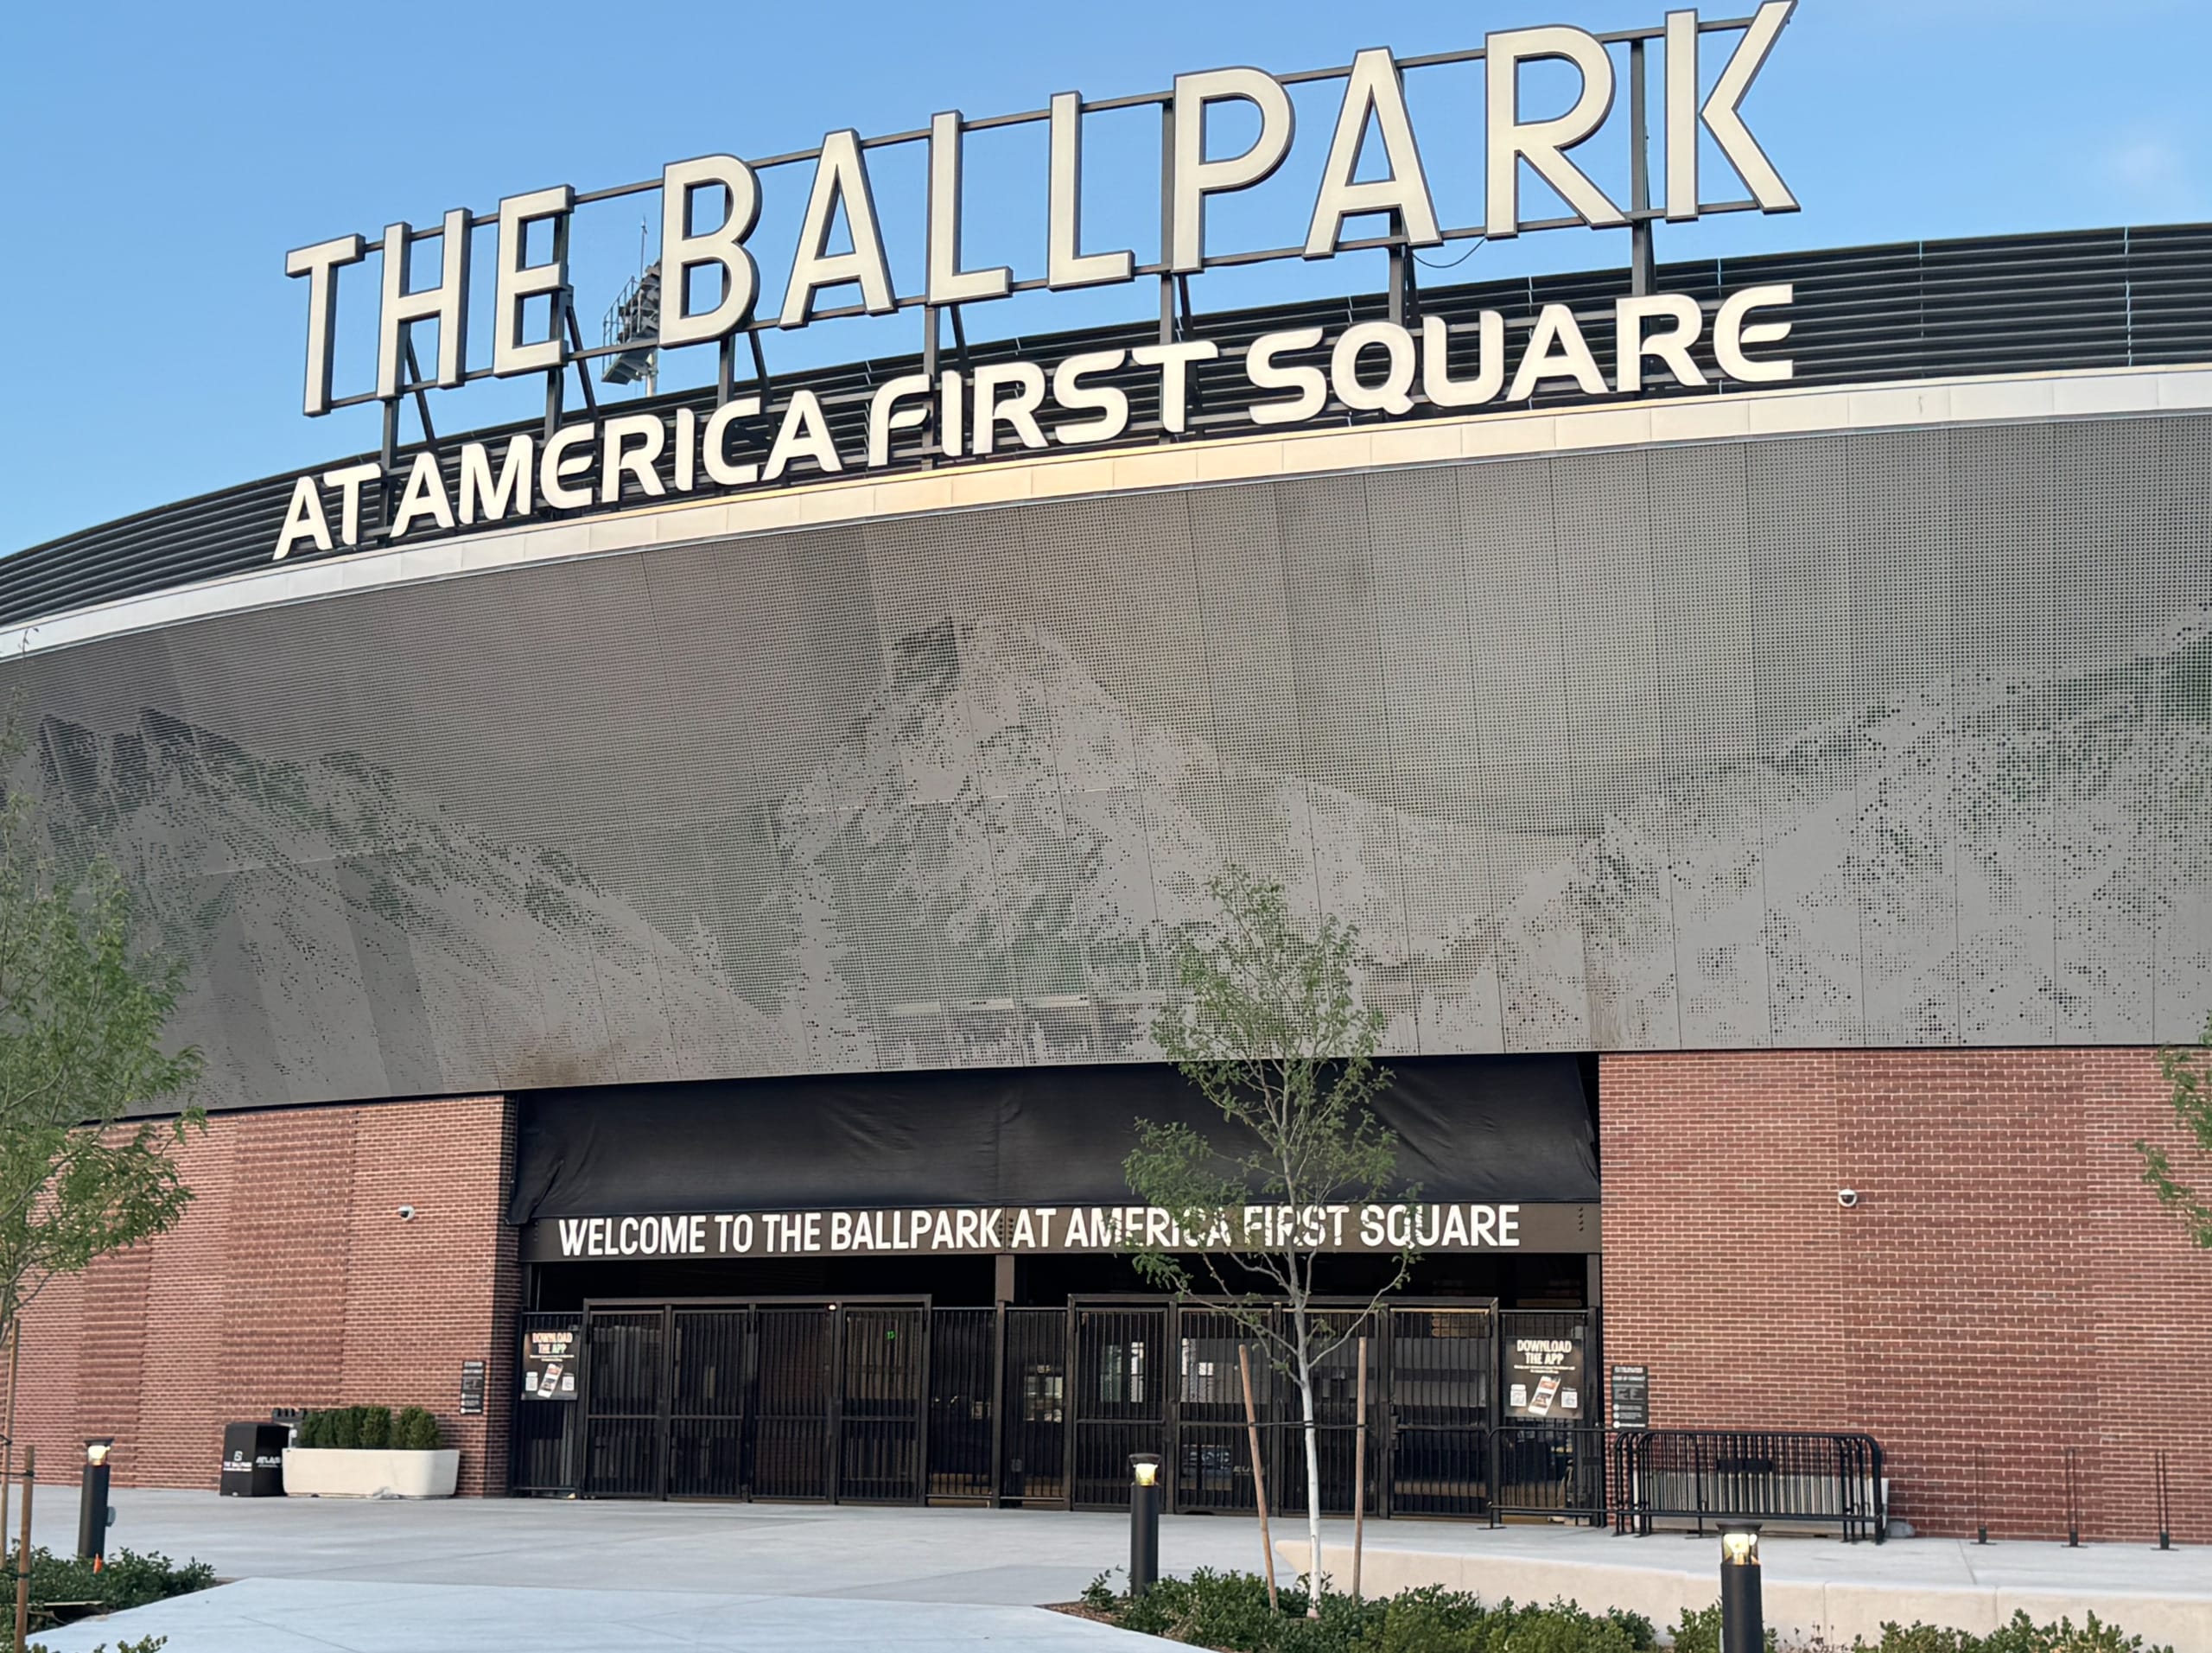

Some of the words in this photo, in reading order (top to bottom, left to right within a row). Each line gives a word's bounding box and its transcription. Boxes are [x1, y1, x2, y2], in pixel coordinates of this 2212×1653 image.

[285, 184, 575, 416] THE
[658, 0, 1800, 349] BALLPARK
[271, 462, 382, 561] AT
[390, 389, 842, 539] AMERICA
[868, 340, 1220, 467] FIRST
[1248, 283, 1794, 424] SQUARE
[558, 1215, 706, 1256] WELCOME
[715, 1214, 753, 1253] TO
[762, 1212, 821, 1252] THE
[830, 1209, 1002, 1250] BALLPARK
[1011, 1208, 1057, 1248] AT
[1244, 1205, 1350, 1247] FIRST
[1360, 1204, 1520, 1249] SQUARE
[532, 1332, 573, 1343] DOWNLOAD
[1516, 1339, 1573, 1353] DOWNLOAD
[1525, 1352, 1543, 1364] THE
[1544, 1353, 1564, 1364] APP
